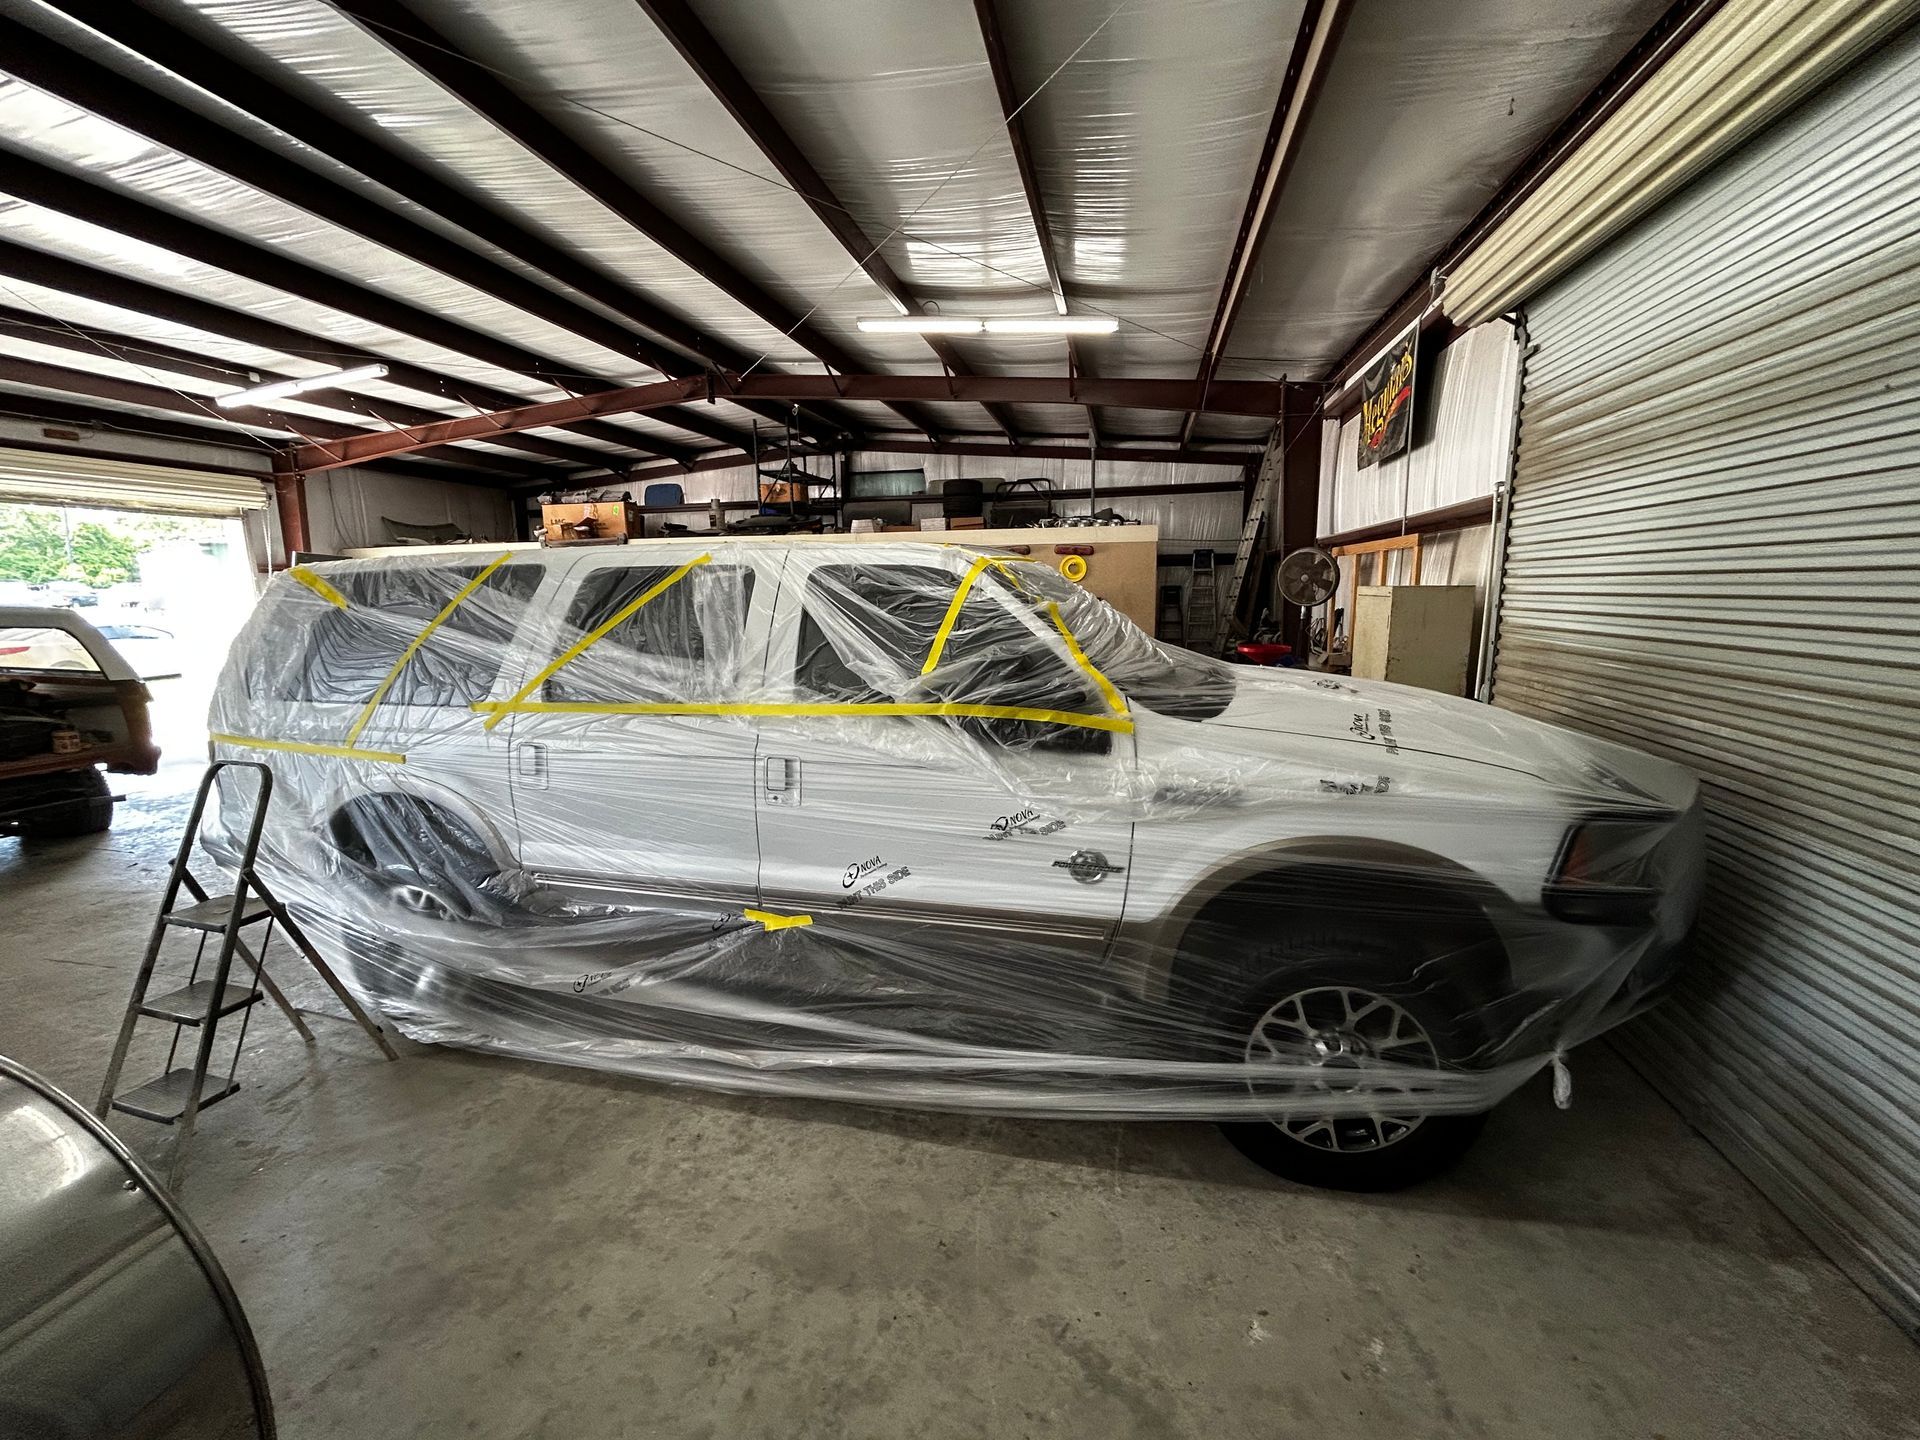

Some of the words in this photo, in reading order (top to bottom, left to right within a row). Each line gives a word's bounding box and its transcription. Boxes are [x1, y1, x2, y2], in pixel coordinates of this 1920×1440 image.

[1010, 809, 1033, 826] NOVA
[861, 856, 882, 872] NOVA
[863, 878, 887, 896] THIS
[887, 866, 911, 885] SIDE
